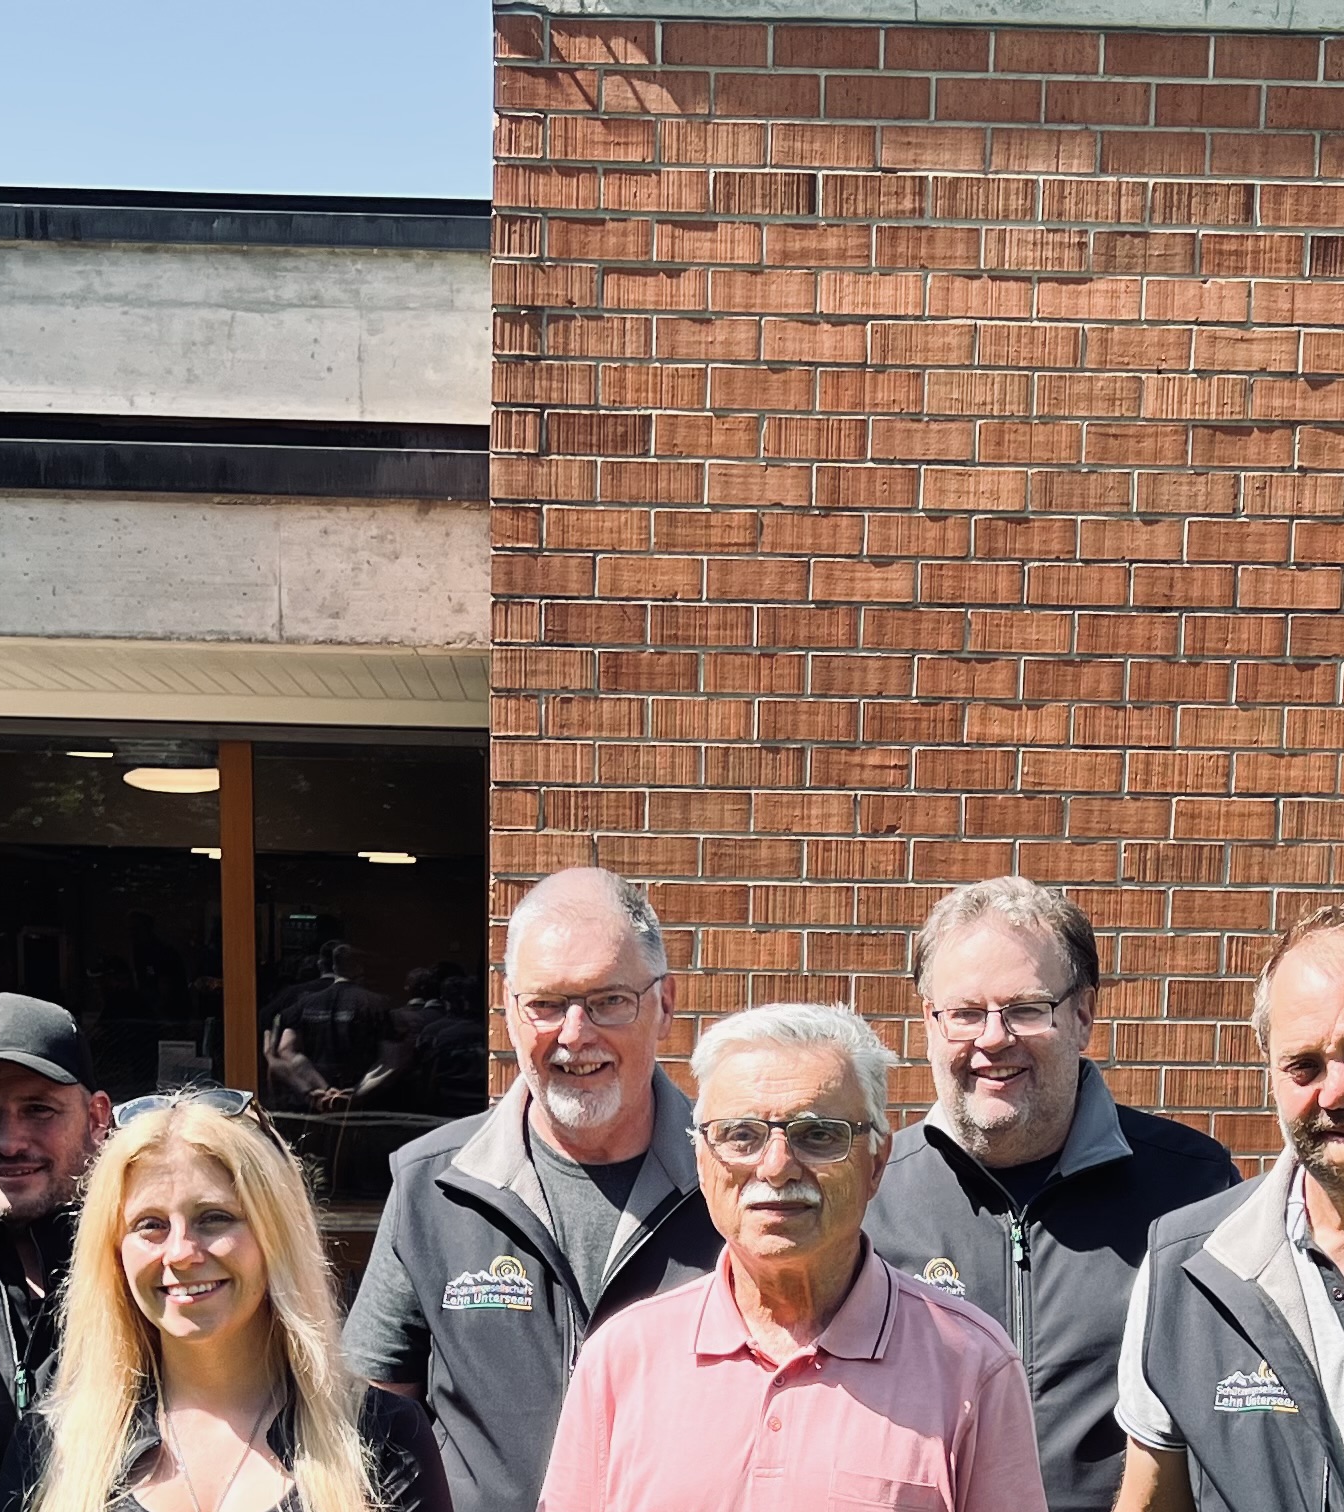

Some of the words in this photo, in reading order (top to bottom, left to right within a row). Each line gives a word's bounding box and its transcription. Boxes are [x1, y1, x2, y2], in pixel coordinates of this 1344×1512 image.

[443, 1293, 472, 1305] Lehn
[473, 1293, 532, 1305] Unterseen
[1215, 1395, 1244, 1408] Lehn
